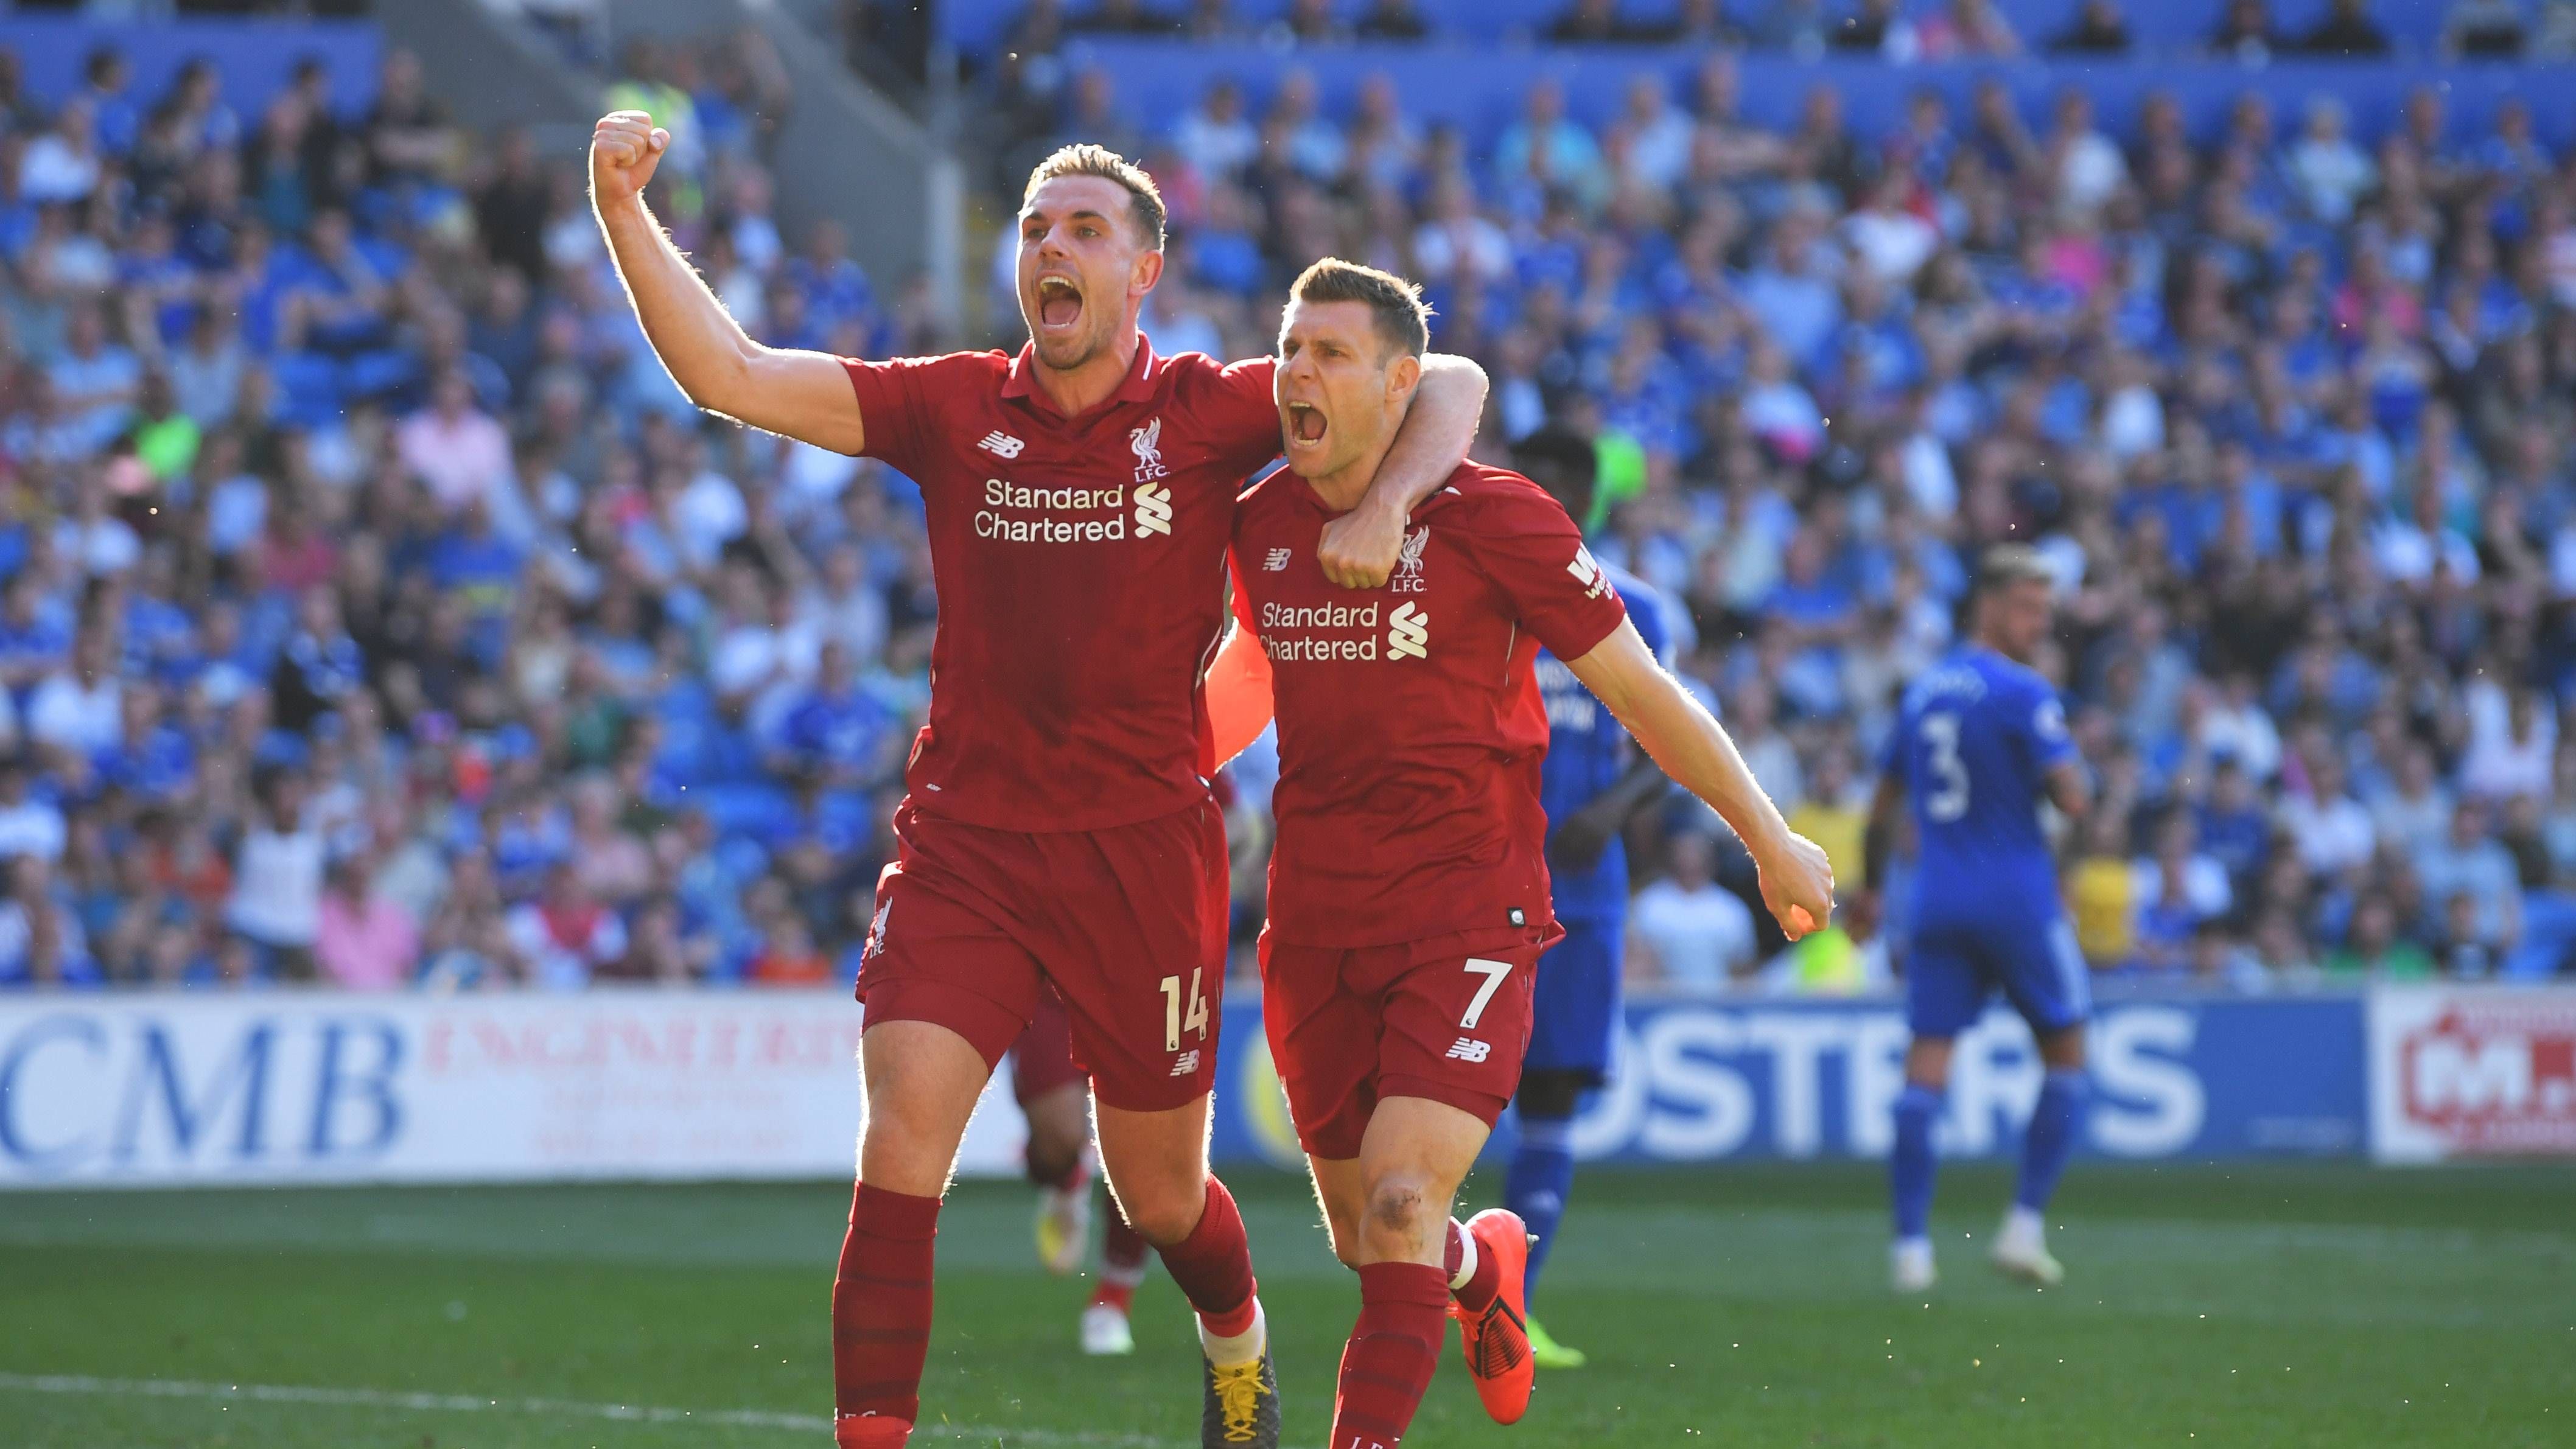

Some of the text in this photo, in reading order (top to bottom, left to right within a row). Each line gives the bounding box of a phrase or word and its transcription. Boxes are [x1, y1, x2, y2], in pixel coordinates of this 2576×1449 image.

[975, 509, 1125, 543] Chartered
[985, 478, 1124, 509] Standard
[1262, 601, 1379, 628] Standard
[1920, 712, 1971, 822] 3
[1160, 966, 1209, 1052] 14
[1460, 958, 1513, 1029] 7
[0, 1011, 409, 1158] CMB
